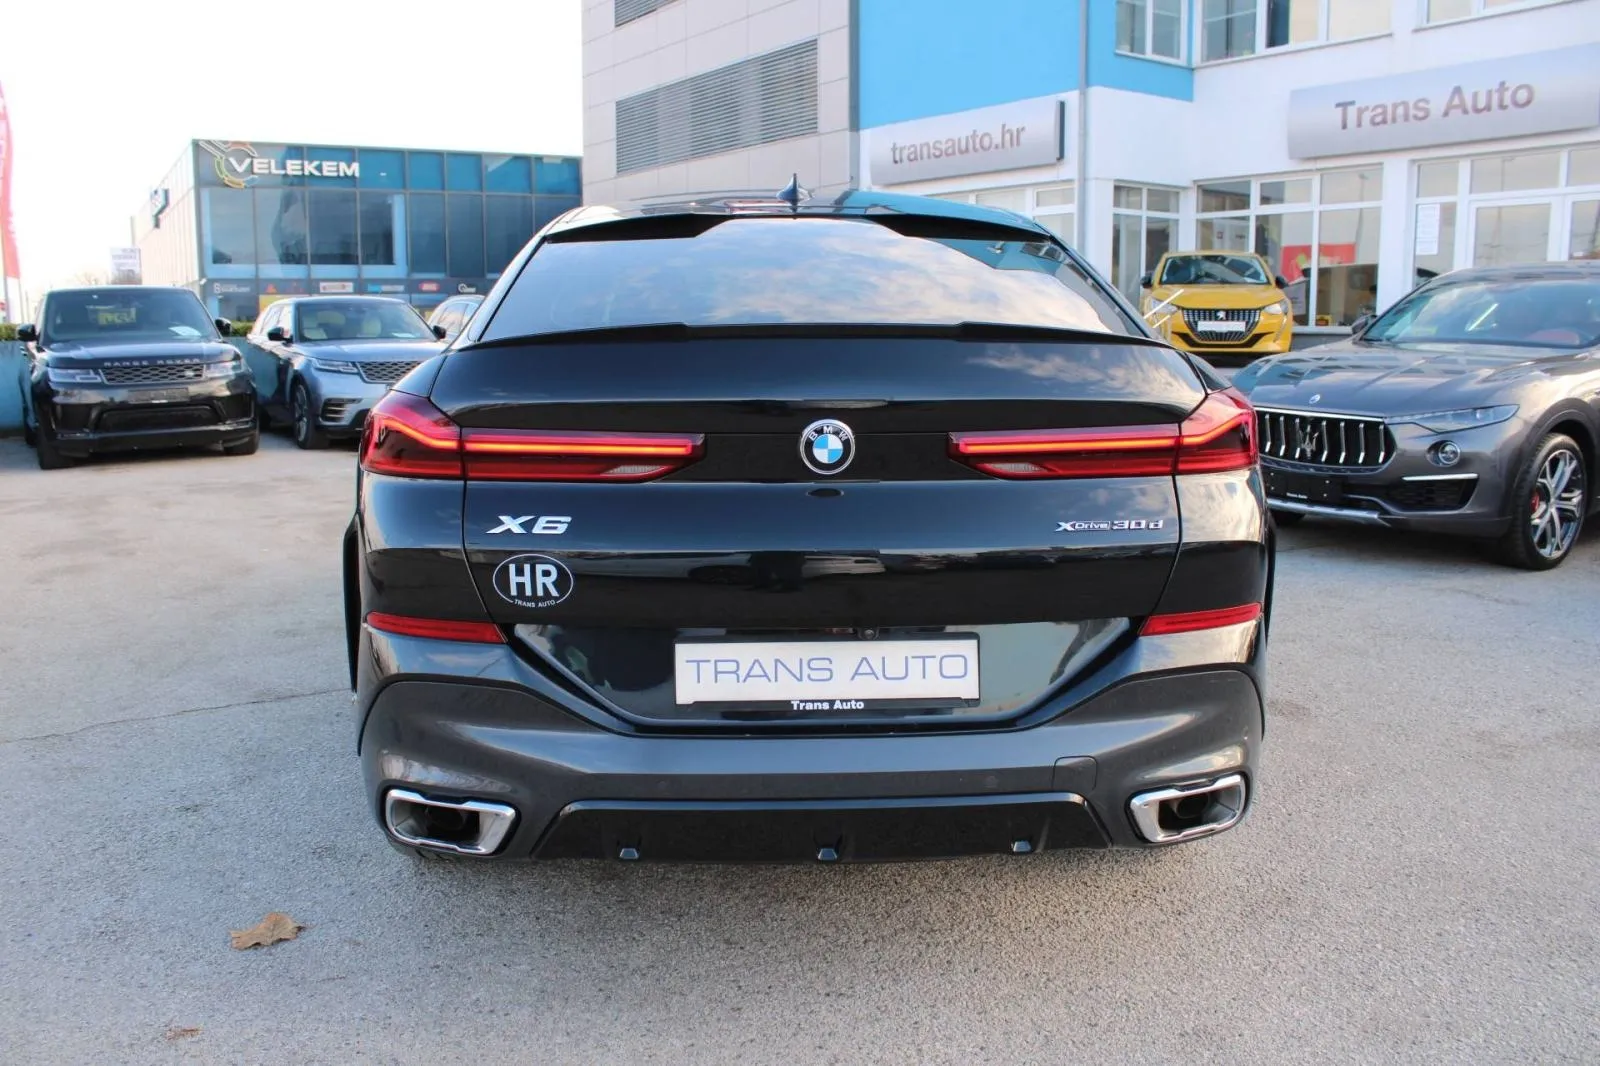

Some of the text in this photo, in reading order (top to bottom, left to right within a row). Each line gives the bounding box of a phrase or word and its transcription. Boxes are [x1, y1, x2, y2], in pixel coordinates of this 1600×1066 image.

[1334, 80, 1535, 130] Trans Auto
[891, 123, 1026, 165] transauto.hr
[228, 157, 360, 177] VELEKEM
[808, 425, 850, 442] BMW
[485, 515, 572, 534] X6
[508, 563, 560, 597] HR
[514, 599, 556, 608] TRANS AUTO
[685, 654, 969, 684] TRANS AUTO
[791, 700, 864, 710] Trans Auto
